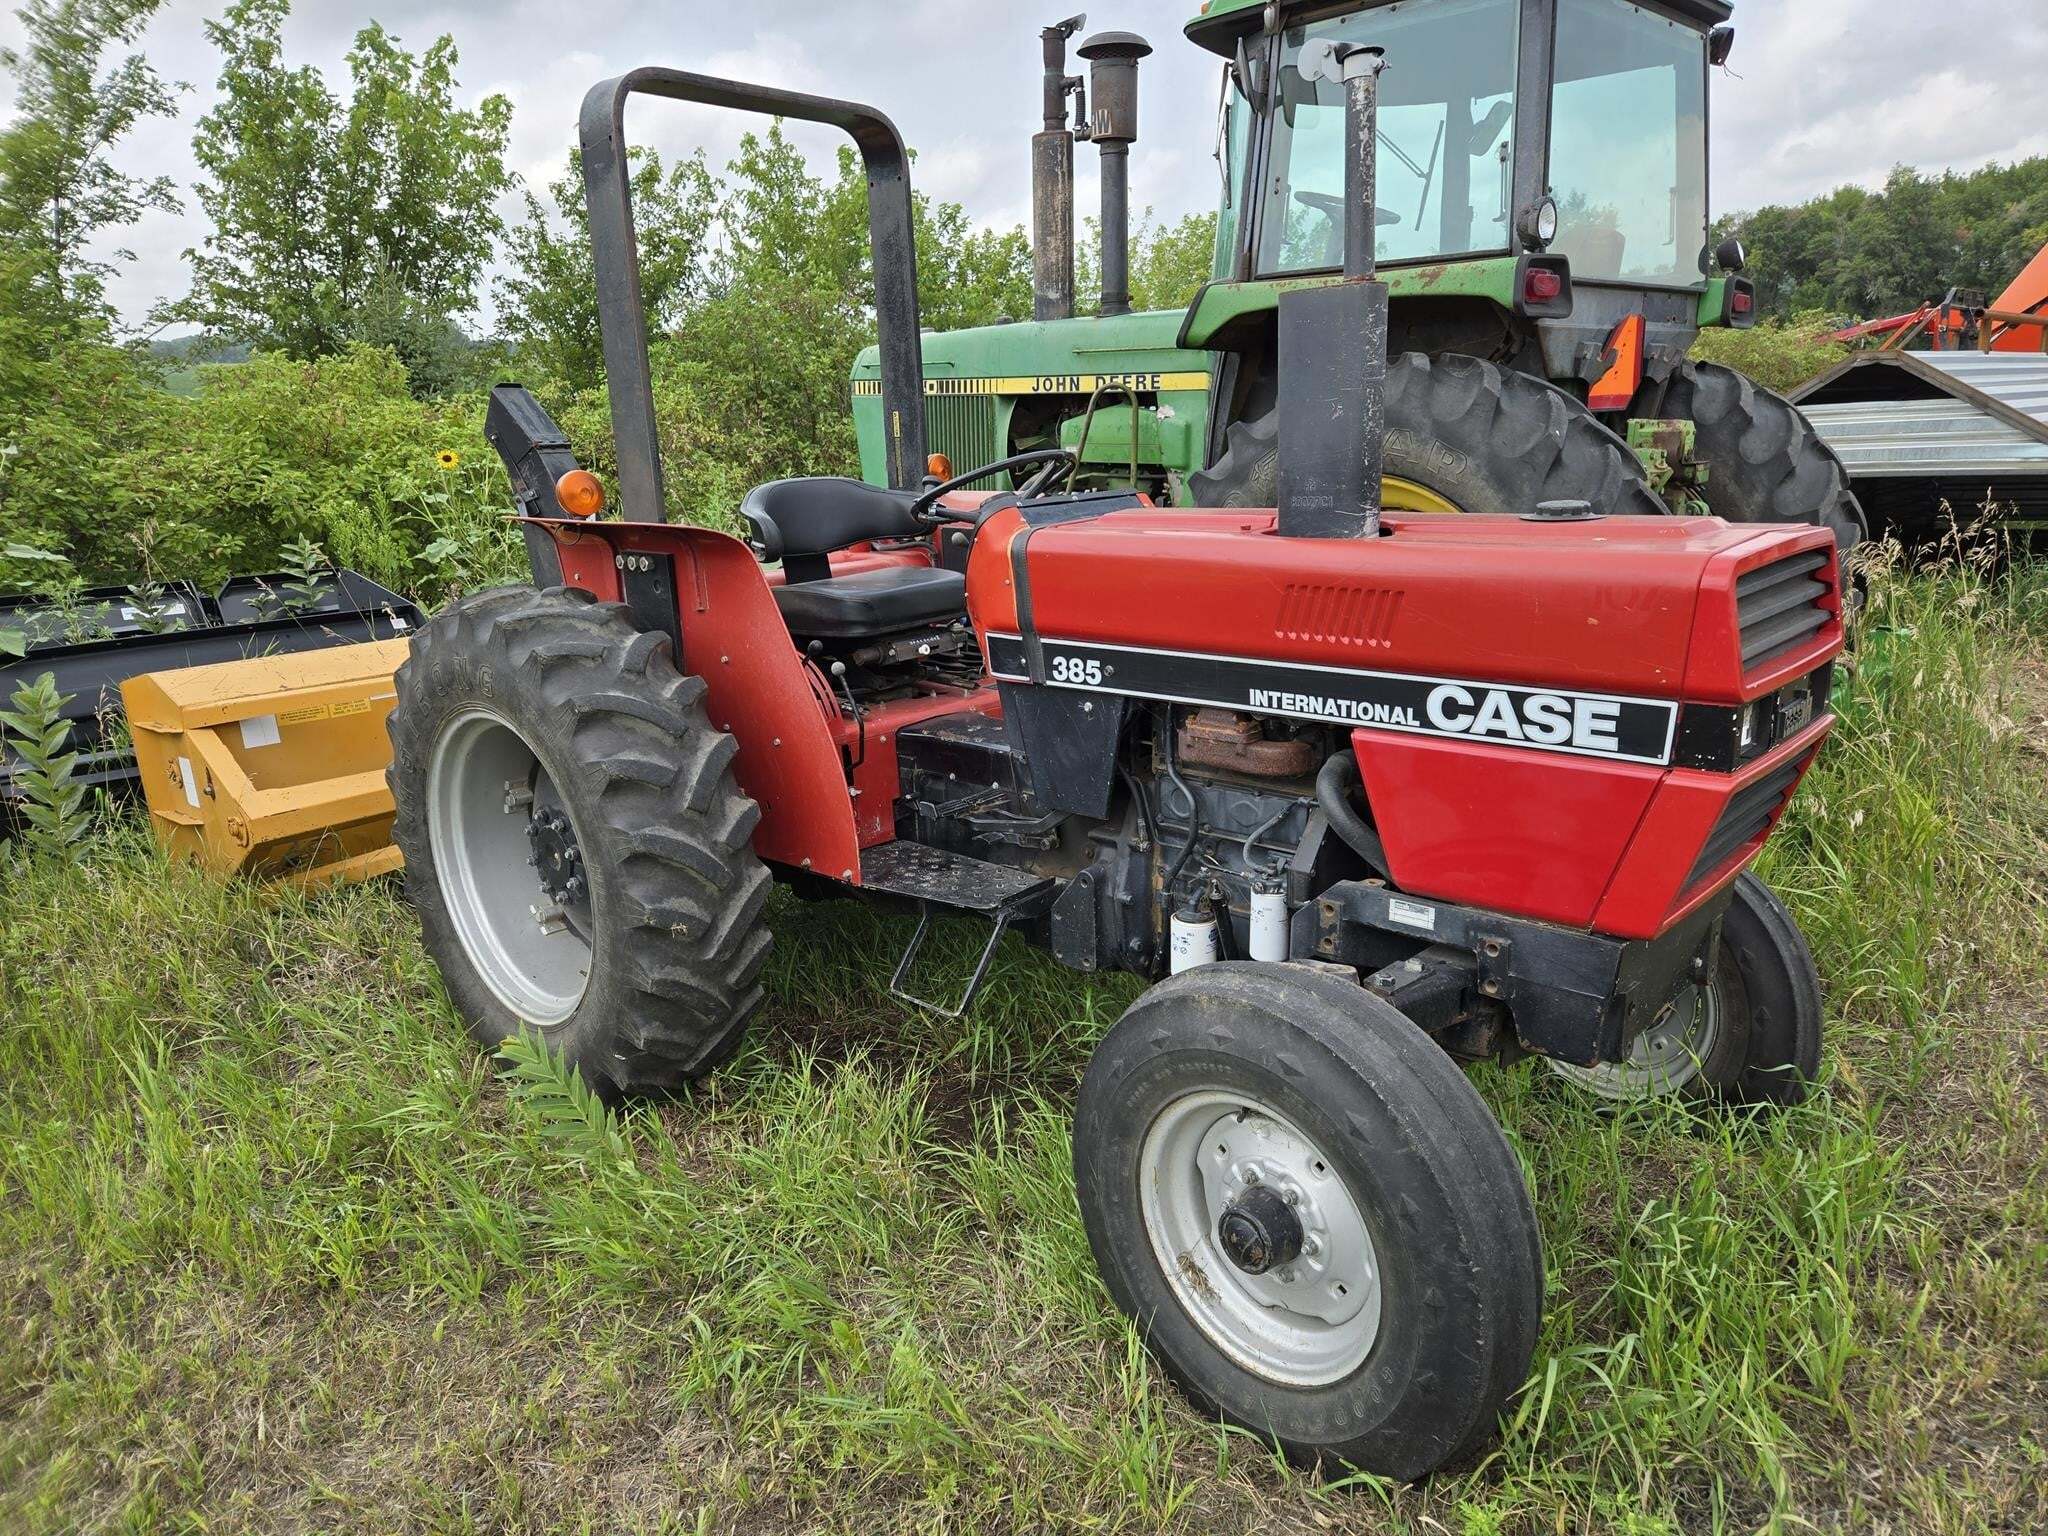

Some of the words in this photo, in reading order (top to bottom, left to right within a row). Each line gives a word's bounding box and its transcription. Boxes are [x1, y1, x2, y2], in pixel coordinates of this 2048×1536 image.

[1031, 376, 1080, 392] JOHN
[1095, 374, 1161, 391] DEERE
[1051, 656, 1102, 686] 385
[1248, 688, 1421, 728] INTERNATIONAL
[1425, 684, 1622, 752] CASE
